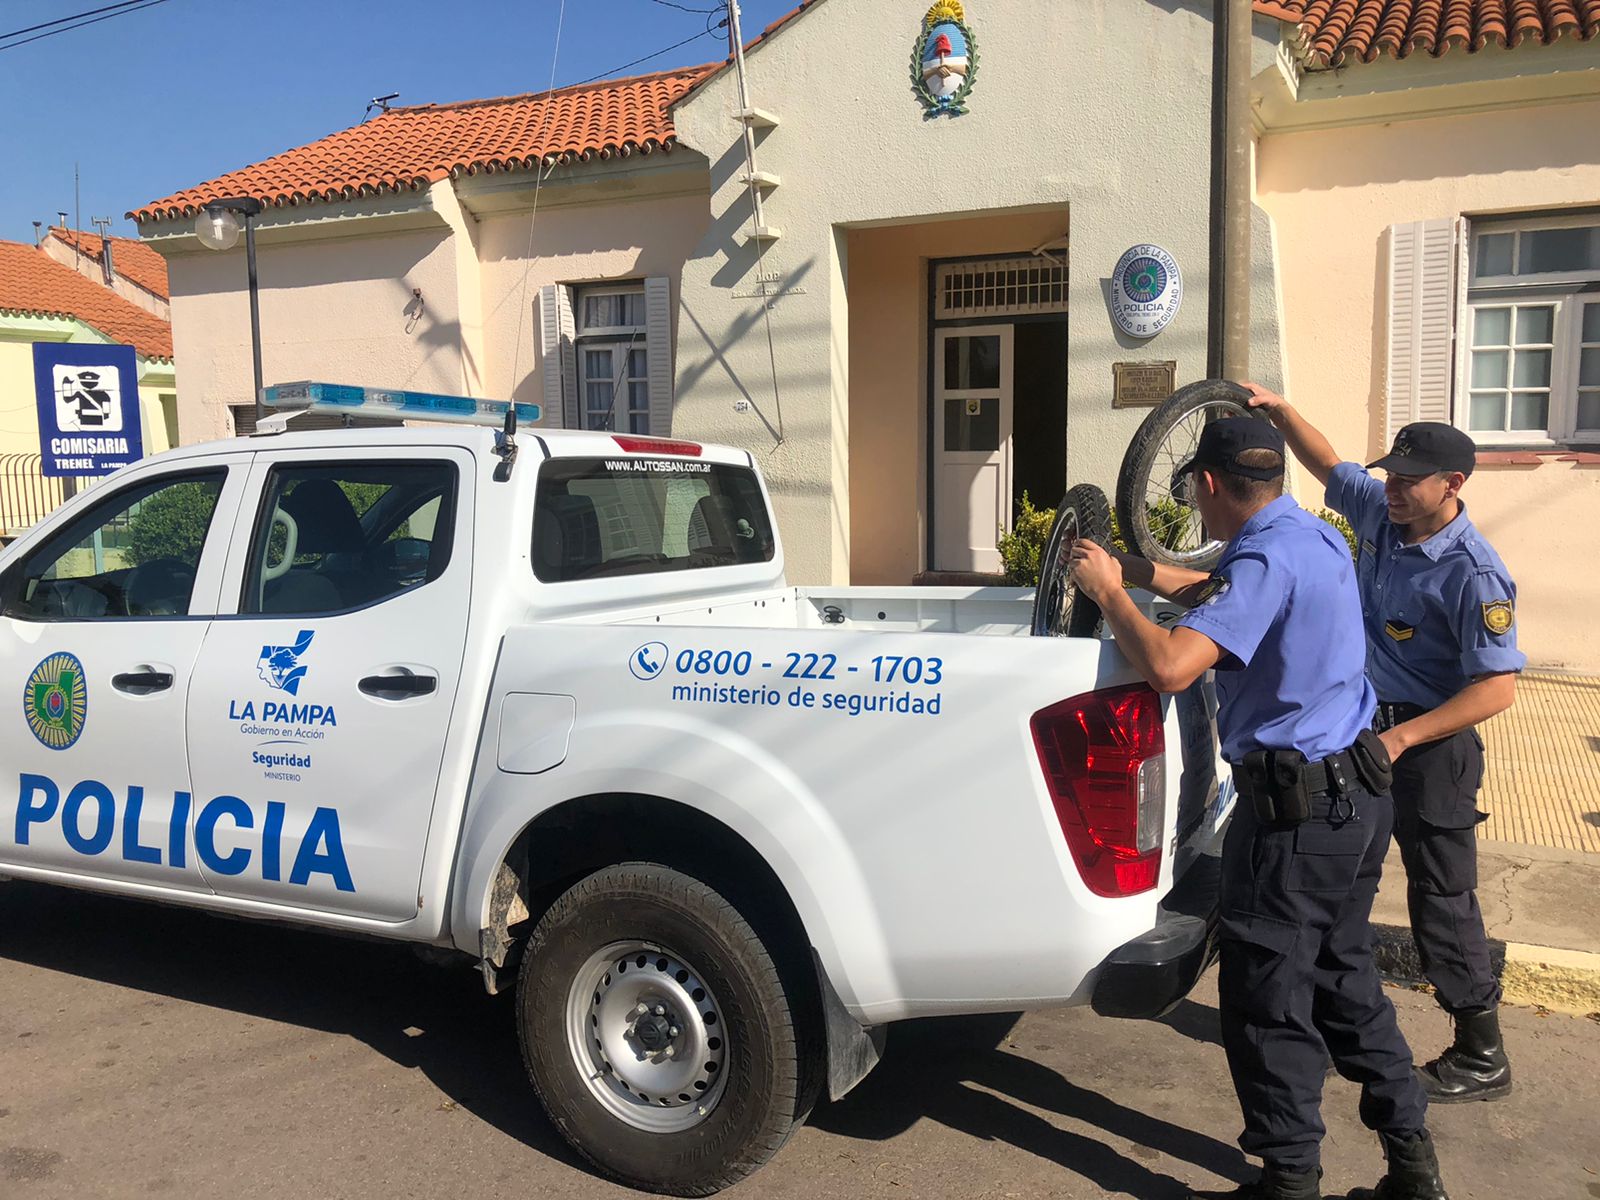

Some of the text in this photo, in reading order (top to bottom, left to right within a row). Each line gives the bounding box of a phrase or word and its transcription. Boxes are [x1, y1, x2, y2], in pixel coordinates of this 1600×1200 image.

[1115, 247, 1177, 281] PROVINCIA DE LA PAMPA
[1113, 288, 1179, 332] MINISTERIO DE SEGURIDAD
[1123, 303, 1164, 312] POLICIA
[51, 438, 129, 455] COMISARIA
[55, 458, 95, 469] TRENEL
[675, 649, 752, 676] 0800
[782, 652, 838, 681] 222
[871, 655, 943, 685] 1703
[672, 682, 941, 717] ministerio de seguridad
[229, 699, 337, 727] LA PAMPA
[240, 722, 325, 740] Gobierno en Acción
[252, 751, 312, 768] Seguridad
[264, 771, 302, 782] MINISTERIO
[15, 772, 356, 893] POLICIA
